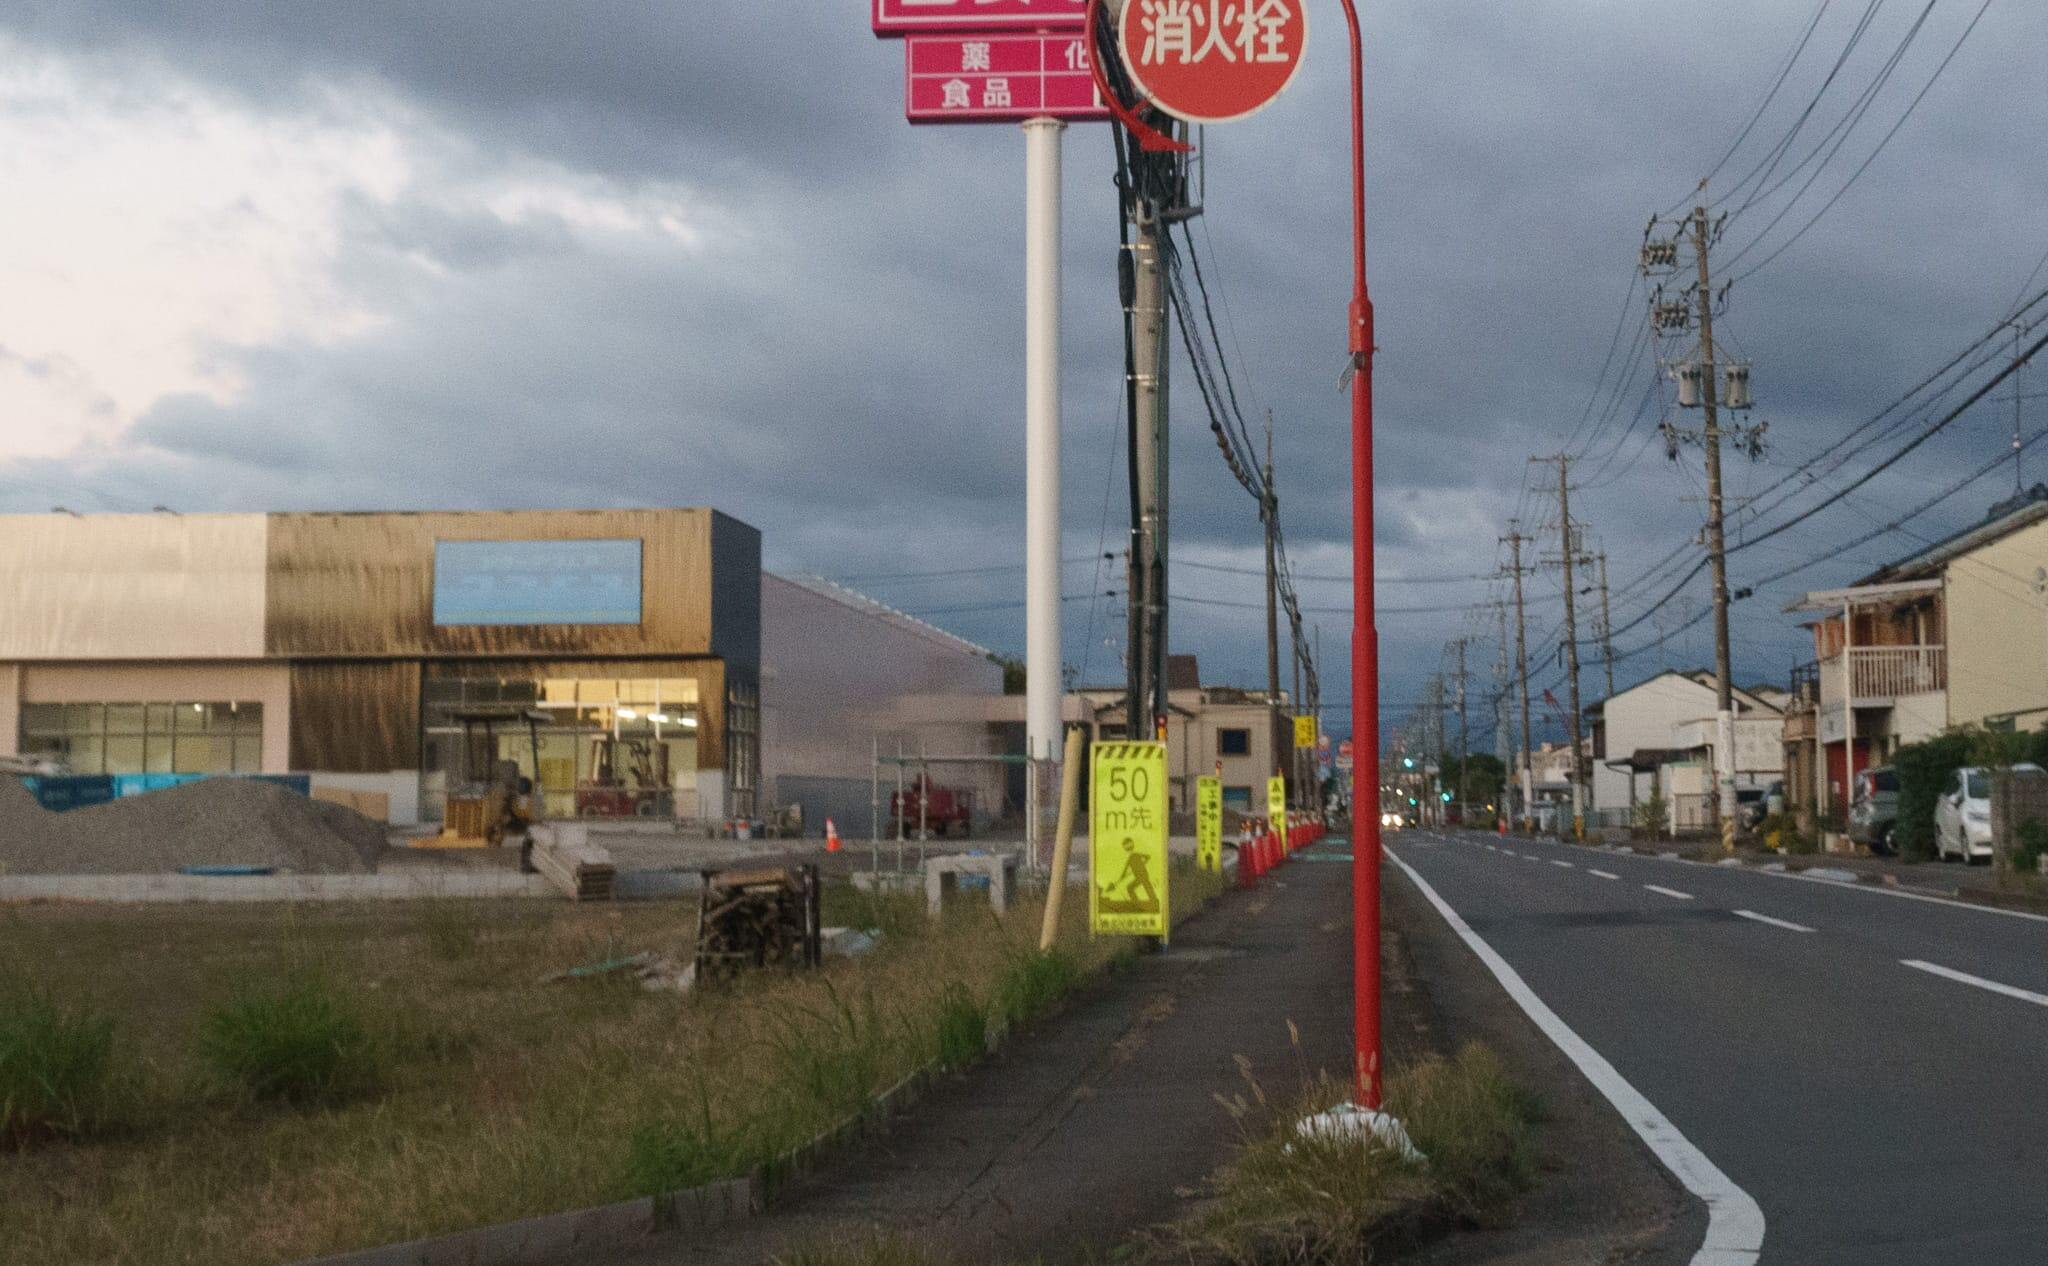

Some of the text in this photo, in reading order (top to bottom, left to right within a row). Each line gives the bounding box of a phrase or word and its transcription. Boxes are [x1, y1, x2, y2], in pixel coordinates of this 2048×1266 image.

[1141, 0, 1291, 65] 消火栓
[962, 42, 990, 71] 薬
[942, 78, 1011, 107] 食品
[1110, 766, 1148, 802] 50
[1105, 807, 1152, 829] m先
